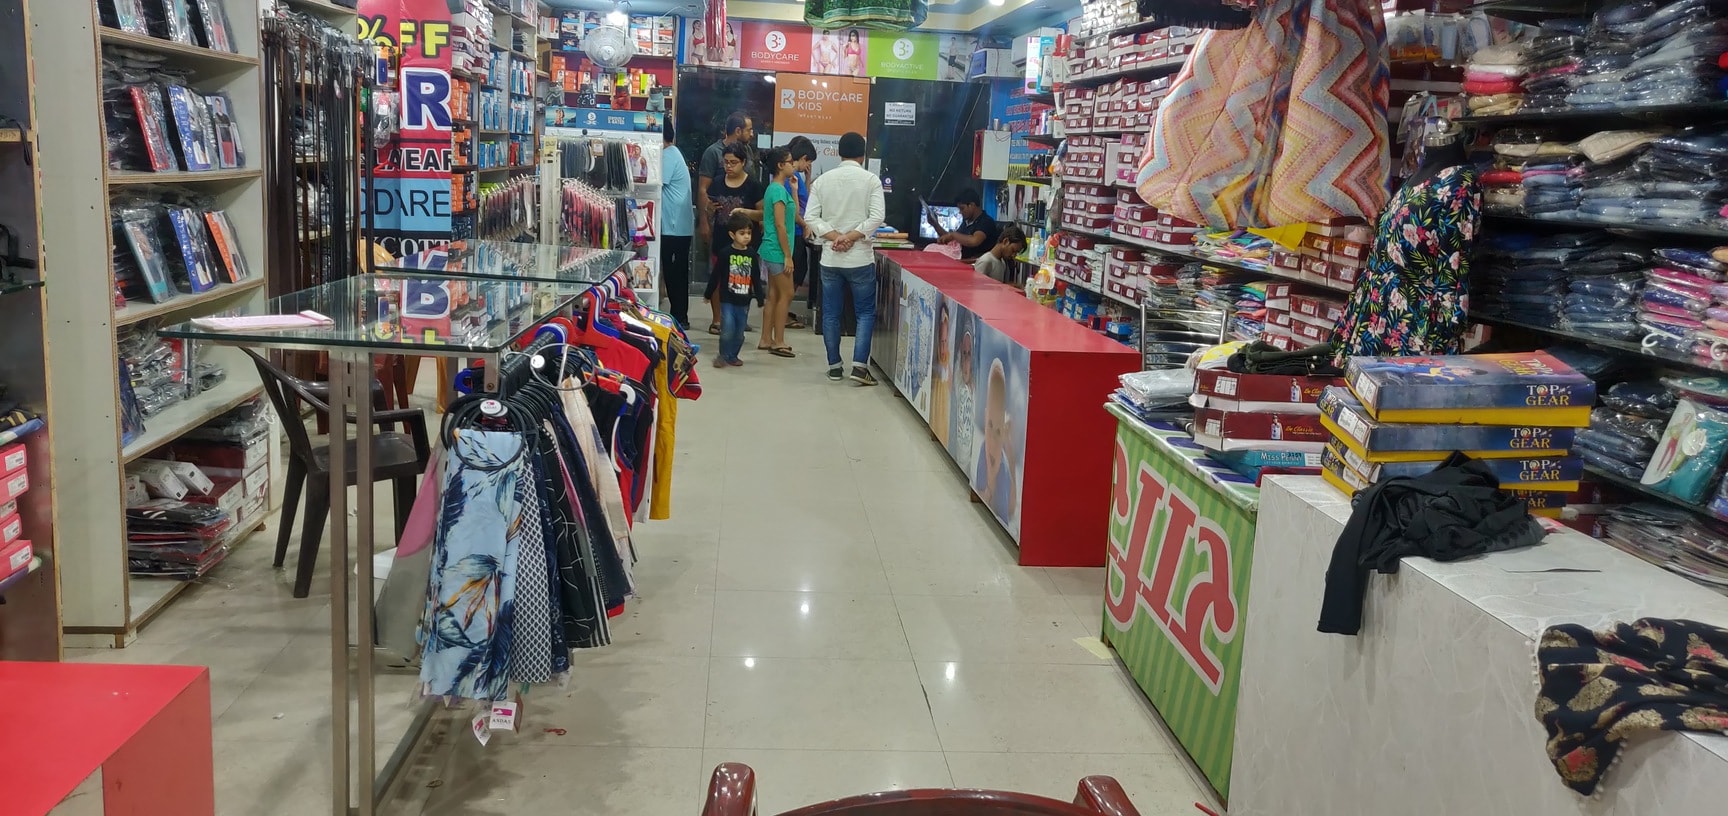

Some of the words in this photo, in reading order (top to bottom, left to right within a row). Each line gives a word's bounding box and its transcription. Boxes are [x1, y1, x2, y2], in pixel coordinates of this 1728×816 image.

[751, 51, 800, 61] BODYCARE
[797, 90, 863, 103] BODYCARE
[797, 102, 822, 111] KIDS
[1527, 384, 1560, 396] TOP
[1525, 396, 1569, 406] GEAR
[1511, 427, 1542, 438] TOP
[1510, 438, 1550, 449] GEAR
[1520, 459, 1550, 470] TOP
[1519, 470, 1560, 481] GEAR
